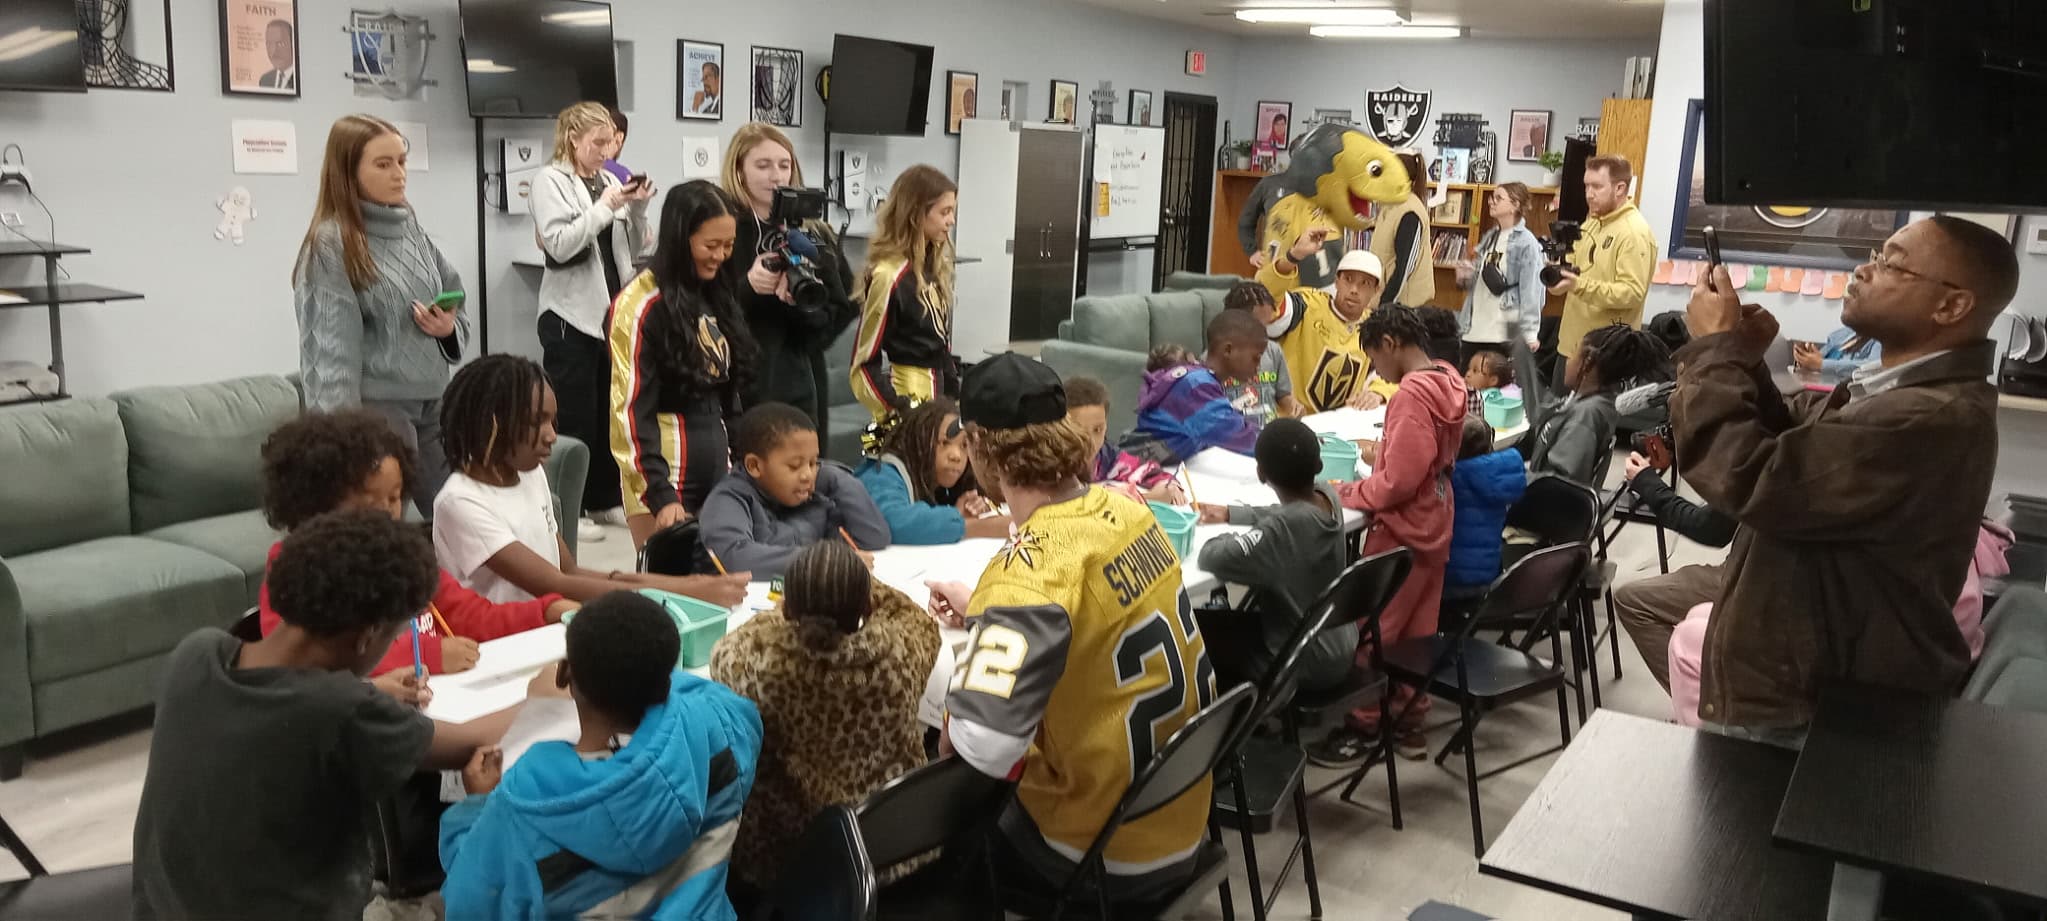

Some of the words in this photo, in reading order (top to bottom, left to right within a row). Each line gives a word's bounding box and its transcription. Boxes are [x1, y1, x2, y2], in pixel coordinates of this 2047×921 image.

[245, 5, 277, 16] FAITH
[689, 51, 716, 61] ACHIEVE
[1373, 93, 1422, 103] RAIDERS
